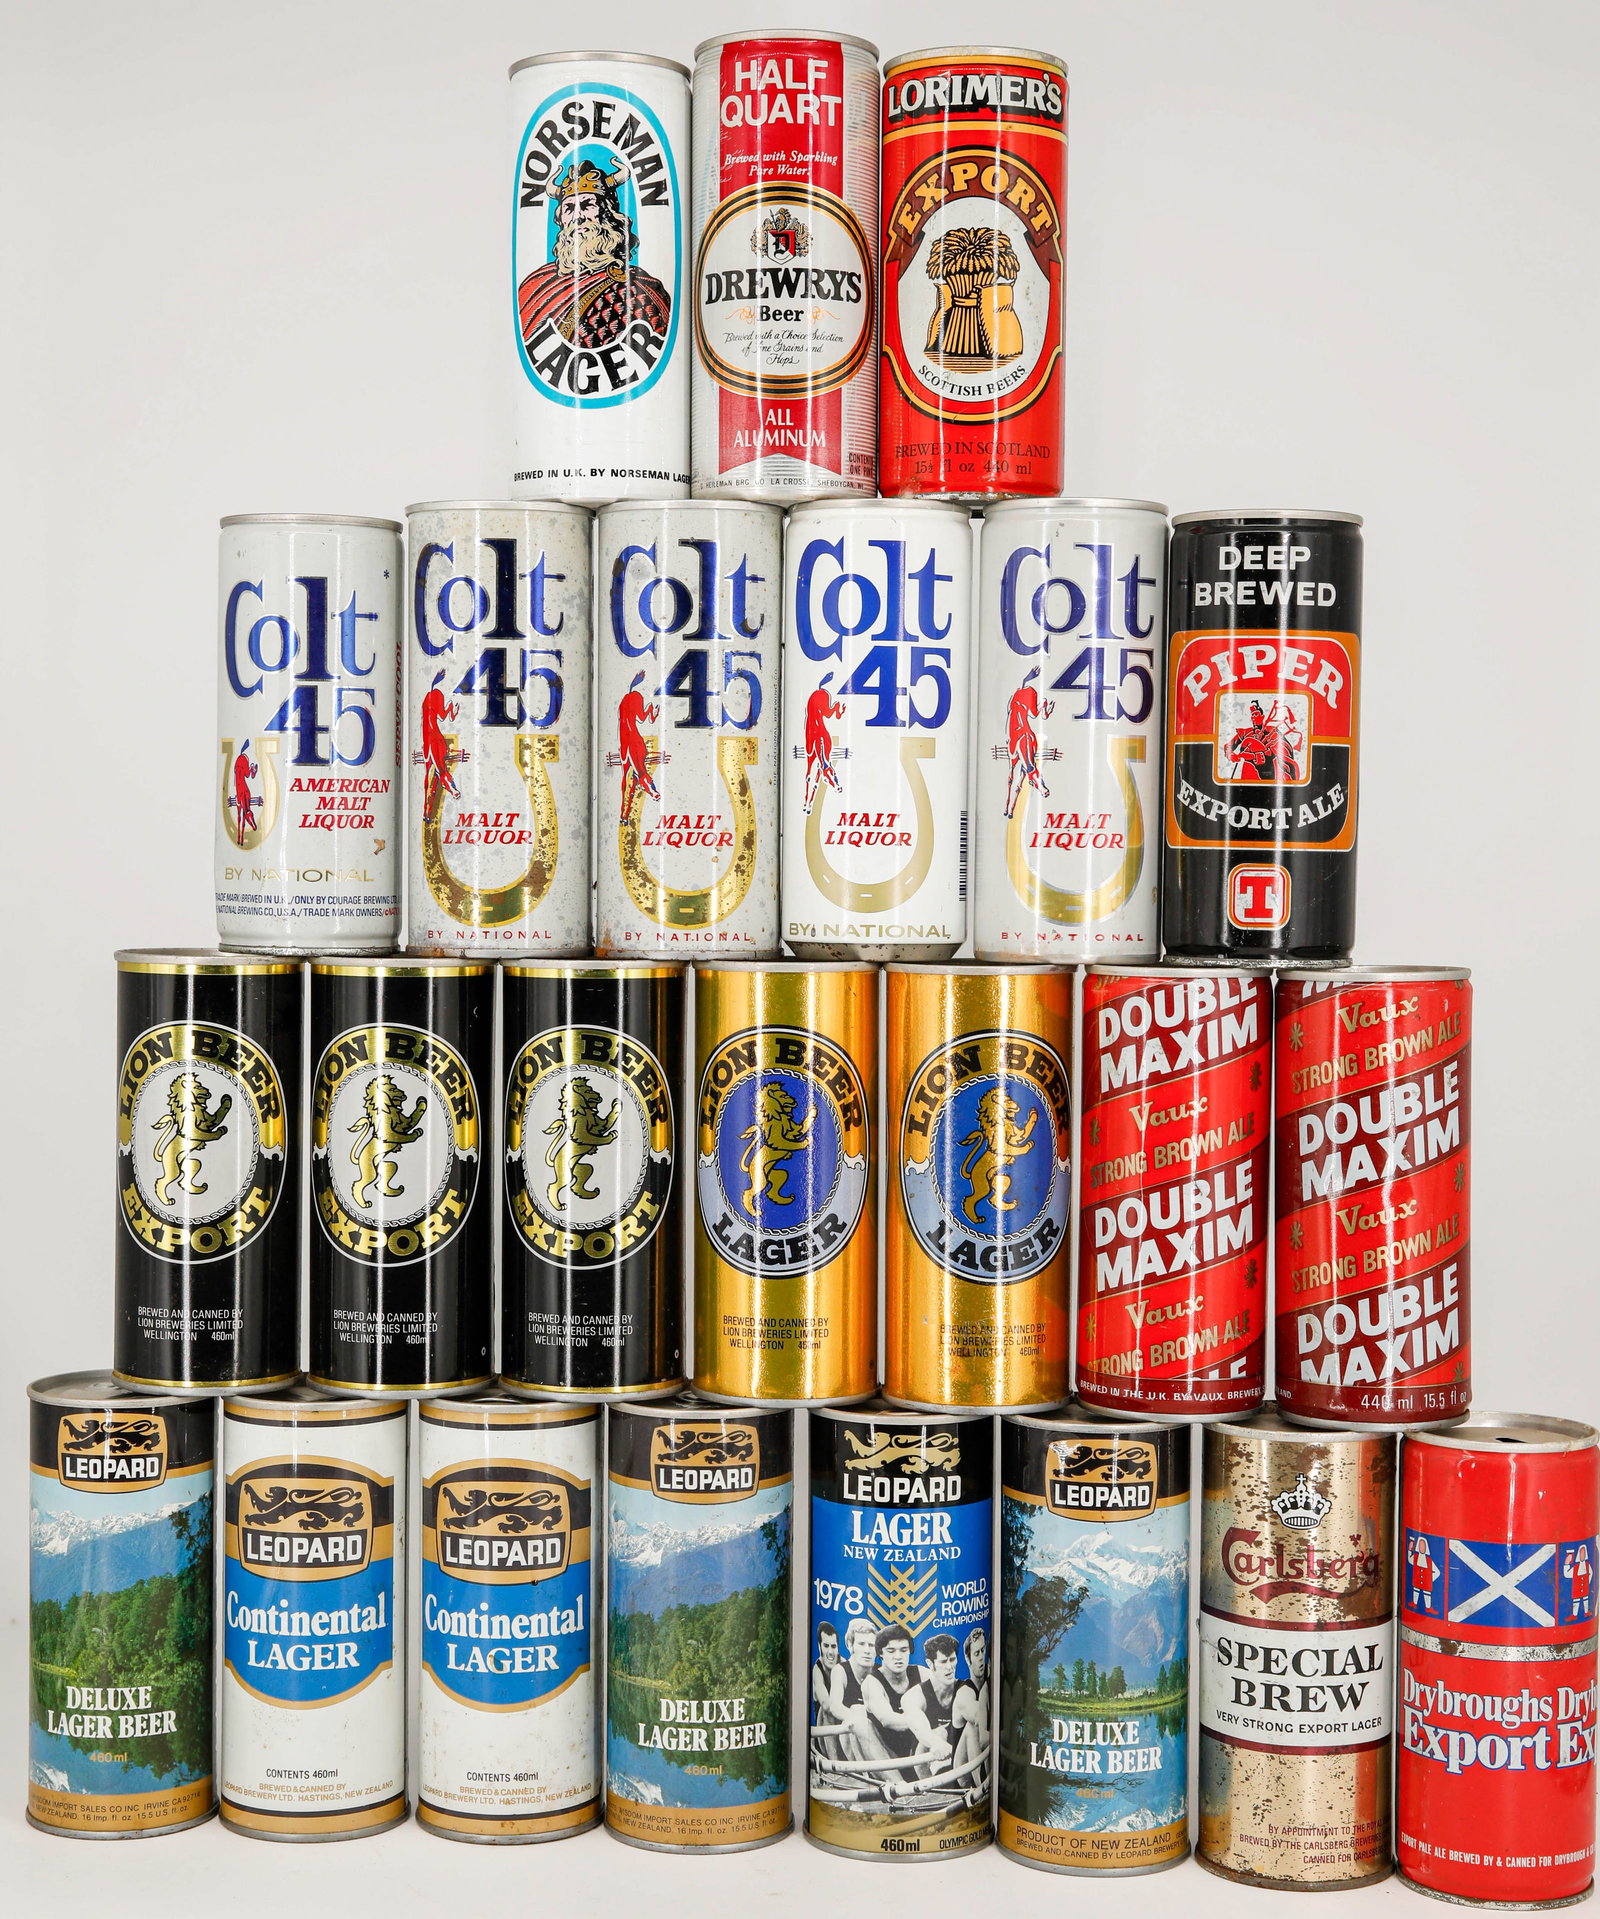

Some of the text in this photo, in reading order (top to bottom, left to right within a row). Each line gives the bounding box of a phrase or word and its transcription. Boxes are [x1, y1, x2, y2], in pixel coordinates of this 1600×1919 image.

[734, 58, 829, 92] HALF
[721, 93, 842, 128] QUART
[888, 72, 1064, 124] LORIMER'S
[520, 101, 669, 209] NORSEMAN
[725, 150, 838, 167] Brewed with Sparkling
[898, 162, 1053, 236] EXPORT
[705, 267, 862, 305] DREWRYS
[758, 305, 804, 322] Beer
[525, 323, 664, 395] LAGER
[918, 364, 1027, 396] SCOTTISH BEERS
[765, 408, 794, 426] ALL
[733, 429, 826, 448] ALUMINUM
[955, 442, 1051, 459] IN SCOTLAND
[514, 470, 544, 482] BREWED
[548, 469, 559, 478] IN
[590, 468, 605, 477] BY
[610, 469, 670, 481] NORSEMAN
[1015, 462, 1032, 475] ml
[1218, 545, 1312, 571] DEEP
[415, 538, 566, 658] Colt
[611, 538, 765, 659] Colt
[795, 536, 953, 663] Colt
[1001, 543, 1156, 657] Colt
[1195, 581, 1337, 607] BREWED
[225, 576, 379, 699] Colt
[453, 647, 565, 730] 45
[655, 648, 762, 730] 45
[837, 645, 952, 729] 45
[1049, 647, 1154, 725] 45
[1183, 644, 1344, 709] PIPER
[264, 685, 376, 769] 45
[289, 778, 391, 793] AMERICAN
[315, 796, 372, 811] MALT
[1176, 779, 1345, 830] EXPORT ALE
[298, 814, 376, 832] LIQUOR
[455, 813, 520, 828] MALT
[836, 812, 901, 828] MALT
[443, 829, 533, 846] LIQUOR
[824, 830, 912, 848] LIQUOR
[225, 867, 375, 882] BY NATIONAL
[316, 896, 362, 905] BY COURAGE
[1239, 875, 1279, 918] T
[427, 930, 552, 940] BY NATIONAL
[789, 923, 951, 939] BY NATIONAL
[1338, 995, 1419, 1033] Vaux
[1100, 1002, 1258, 1094] MAXIM
[1292, 1011, 1461, 1095] STRONG BROWN ALE
[120, 1029, 281, 1124] LION BEER
[386, 1032, 476, 1125] BEER
[700, 1038, 863, 1132] LION BEER
[1129, 1096, 1208, 1132] Vaux
[1298, 1060, 1459, 1156] DOUBLE
[1090, 1112, 1256, 1189] STRONG BROWN ALE
[1301, 1106, 1460, 1202] MAXIM
[122, 1182, 270, 1254] EXPORT
[1095, 1158, 1253, 1249] DOUBLE
[319, 1185, 466, 1257] EXPORT
[514, 1188, 660, 1259] EXPORT
[712, 1212, 848, 1266] LAGER
[926, 1217, 1060, 1273] LAGER
[138, 1306, 244, 1319] BREWED AND CANNED BY
[138, 1318, 244, 1331] LION BREWERIES LIMITED
[1297, 1262, 1459, 1355] DOUBLE
[144, 1329, 235, 1341] WELLINGTON 460ml
[1150, 1325, 1219, 1368] BROWN
[1080, 1380, 1144, 1399] BREWED IN THE
[1361, 1392, 1446, 1410] 440 ml 15.5
[65, 1456, 160, 1480] LEOPARD
[659, 1468, 753, 1491] LEOPARD
[843, 1473, 962, 1503] LEOPARD
[1054, 1483, 1150, 1508] LEOPARD
[851, 1510, 953, 1546] LAGER
[246, 1532, 362, 1564] LEOPARD
[445, 1536, 562, 1568] LEOPARD
[843, 1544, 961, 1562] NEW ZEALAND
[1221, 1527, 1380, 1589] Carlsberg
[813, 1577, 864, 1615] 1978
[941, 1577, 987, 1600] WORLD
[941, 1592, 989, 1617] ROWING
[227, 1590, 387, 1637] Continental
[424, 1593, 585, 1640] Continental
[247, 1640, 360, 1671] LAGER
[447, 1643, 560, 1674] LAGER
[1216, 1636, 1384, 1678] SPECIAL
[66, 1686, 152, 1711] DELUXE
[1230, 1676, 1371, 1713] BREW
[1403, 1668, 1553, 1729] Drybroughs
[48, 1710, 178, 1739] LAGER BEER
[660, 1698, 745, 1724] DELUXE
[1216, 1709, 1382, 1734] VERY STRONG EXPORT LAGER
[638, 1722, 767, 1751] LAGER BEER
[1052, 1718, 1140, 1746] DELUXE
[1403, 1705, 1552, 1775] Export
[1030, 1741, 1162, 1774] LAGER BEER
[266, 1768, 338, 1780] CONTENTS 460ml
[80, 1800, 170, 1813] SALES IRVINE
[881, 1836, 969, 1852] 460ml OLYMPIC
[1016, 1825, 1066, 1847] PRODUCT
[1070, 1838, 1087, 1850] OF
[1091, 1839, 1121, 1850] NEW
[1124, 1832, 1171, 1849] ZEALAND
[1064, 1849, 1152, 1860] CANNED BY LEOPARD
[1303, 1855, 1335, 1864] CANNED
[1434, 1846, 1552, 1868] ALE BREWED BY CANNED FOR
